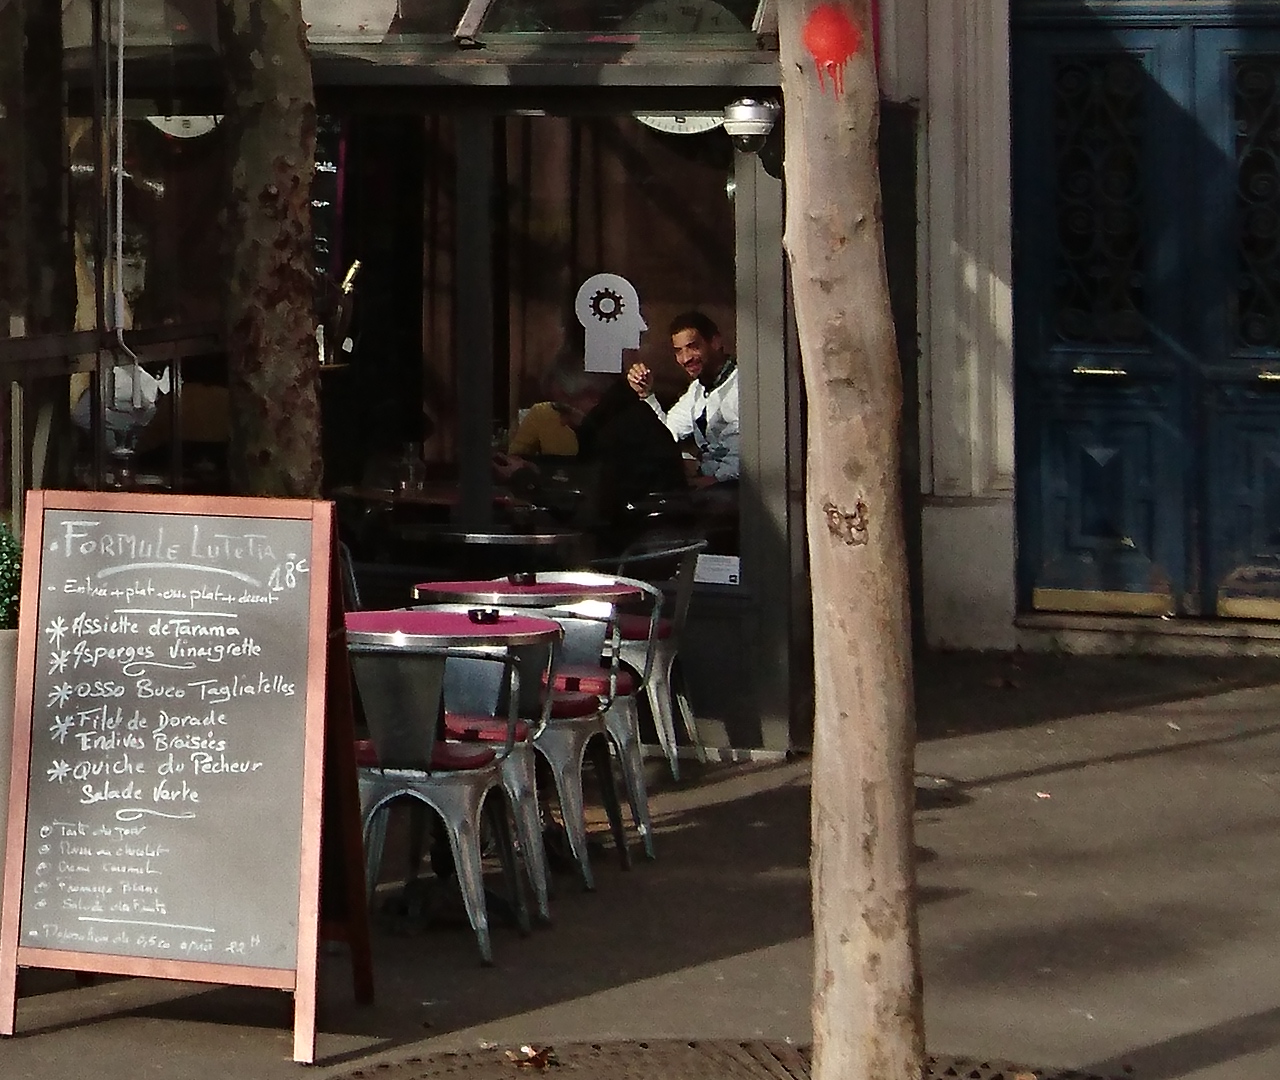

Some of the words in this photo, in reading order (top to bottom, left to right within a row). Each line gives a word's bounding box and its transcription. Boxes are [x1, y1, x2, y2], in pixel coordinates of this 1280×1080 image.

[72, 611, 139, 637] Assiette
[170, 619, 240, 637] Tarama
[72, 641, 155, 669] Asperges
[137, 679, 186, 699] Buco
[189, 672, 296, 705] Tagliatelles
[153, 710, 228, 735] Dorade
[157, 753, 185, 775] du
[79, 781, 143, 804] Salade
